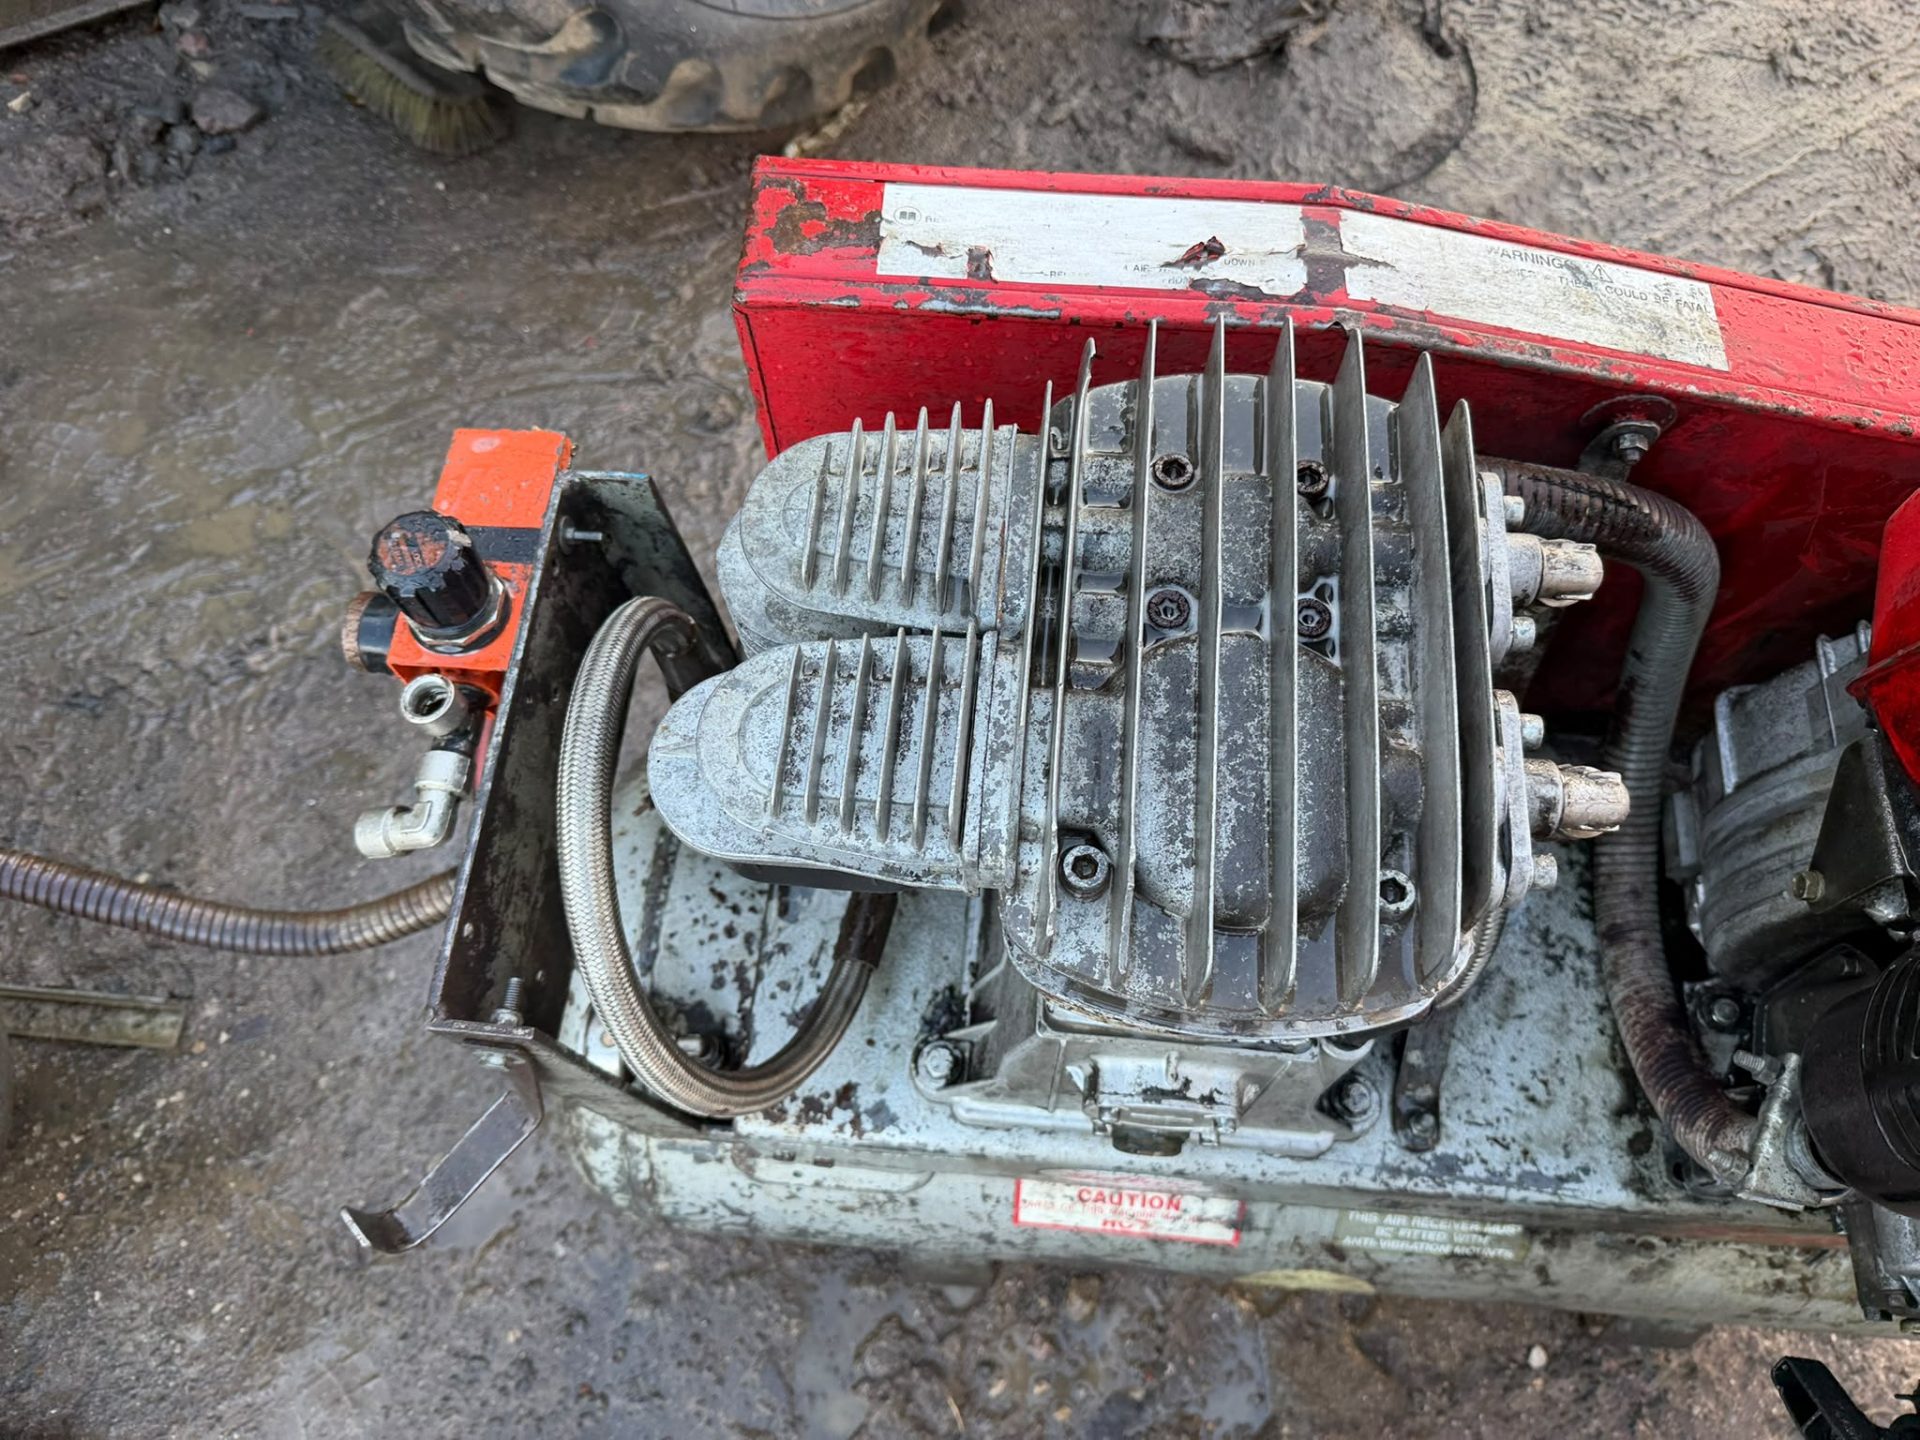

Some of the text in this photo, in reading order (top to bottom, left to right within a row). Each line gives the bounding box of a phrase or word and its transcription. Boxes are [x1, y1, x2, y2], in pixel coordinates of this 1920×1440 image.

[1487, 246, 1567, 269] WARNING
[1605, 285, 1648, 301] COULD
[1676, 299, 1710, 313] FATAL
[1077, 1187, 1181, 1211] CAUTION
[1383, 1213, 1408, 1226] AIR
